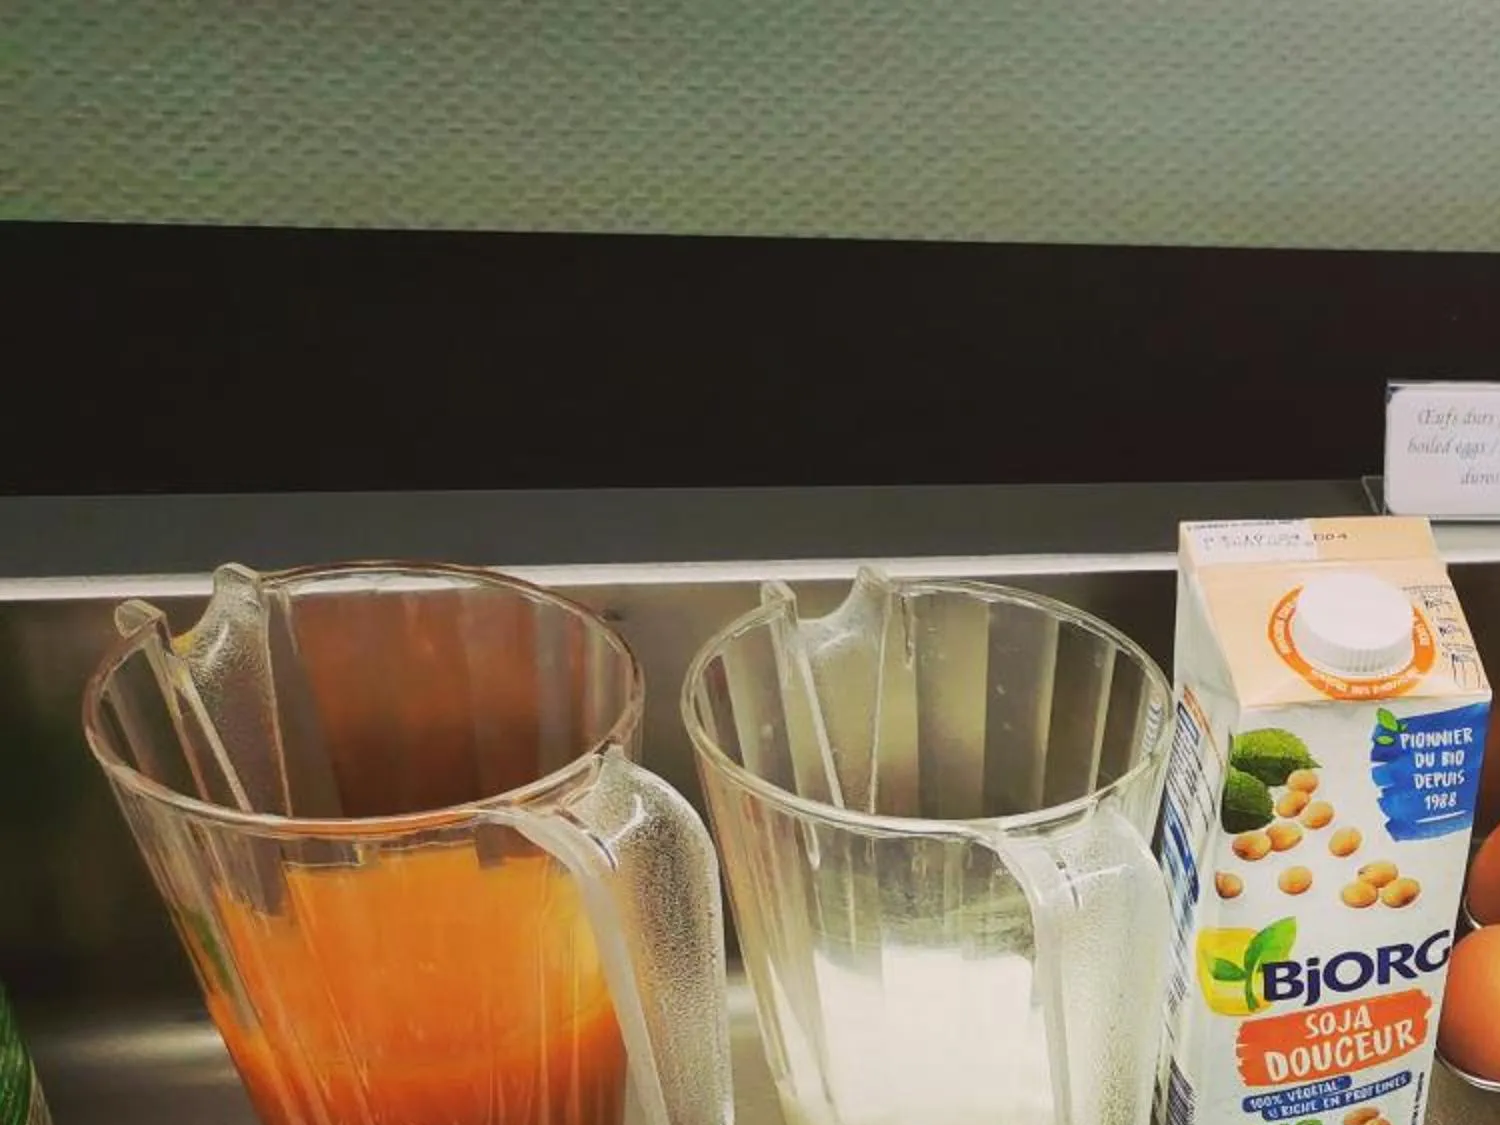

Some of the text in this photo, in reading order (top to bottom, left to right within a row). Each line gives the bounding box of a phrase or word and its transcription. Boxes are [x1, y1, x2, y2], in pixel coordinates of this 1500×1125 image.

[1401, 727, 1473, 750] PIONNIER
[1414, 750, 1465, 767] DU BIO
[1413, 769, 1465, 789] DEPUIS
[1424, 792, 1457, 809] 1988
[1305, 1004, 1373, 1039] SOJA
[1265, 1018, 1416, 1082] DOUCEUR
[1250, 1093, 1283, 1110] 100%
[1281, 1100, 1318, 1116] RICHE
[1323, 1094, 1341, 1109] EN
